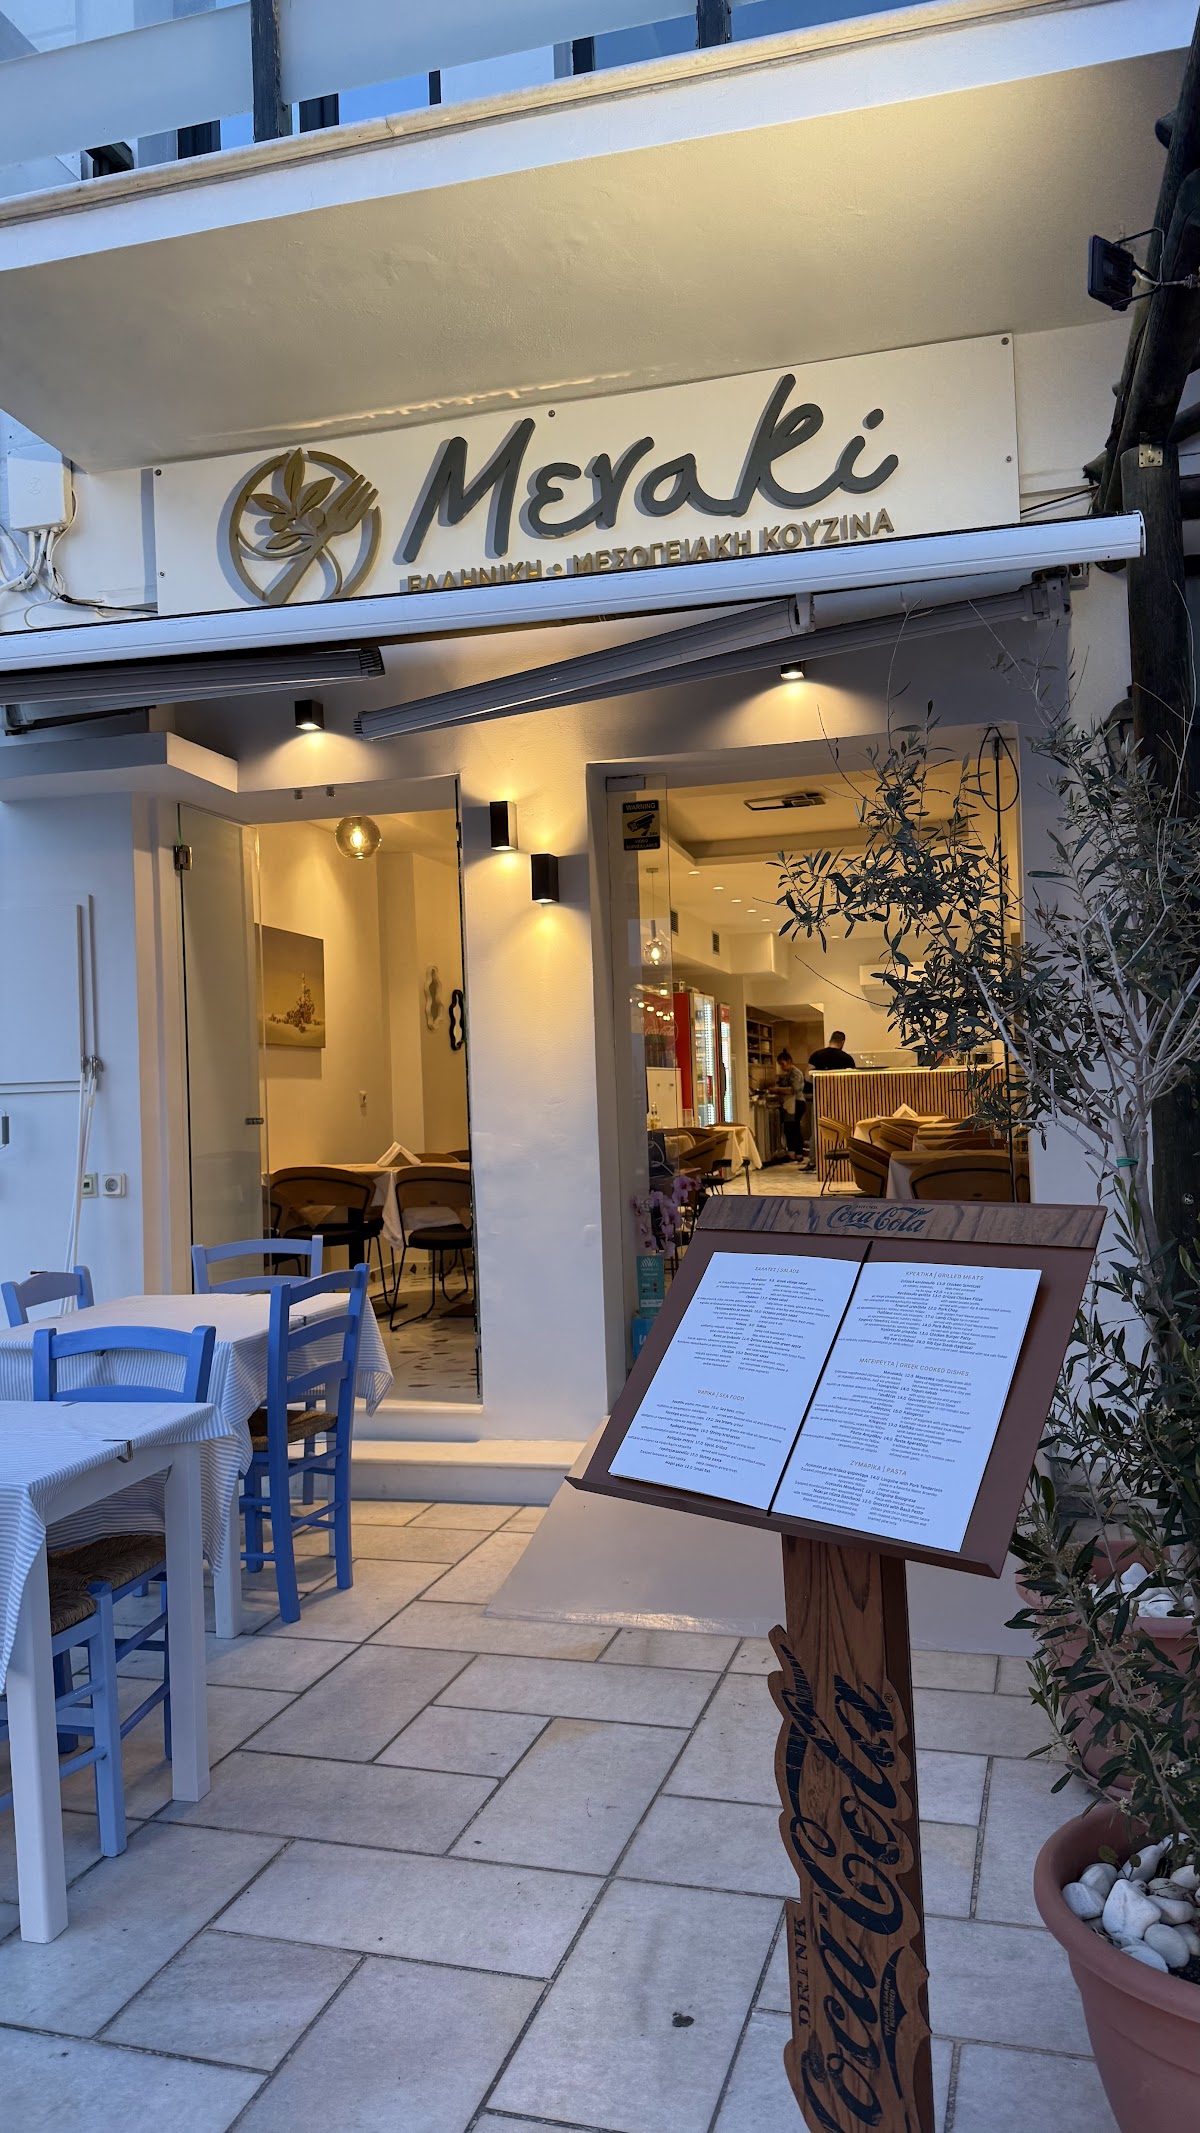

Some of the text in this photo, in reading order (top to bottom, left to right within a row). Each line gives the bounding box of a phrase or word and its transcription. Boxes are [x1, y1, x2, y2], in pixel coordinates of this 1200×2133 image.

[402, 373, 899, 563] Meraki
[406, 508, 895, 593] ΕΛΛΗΝΙΚΗ ΜΕΣΟΓΕΙΑΚΗ ΚΟΥΖΙΝΑ
[625, 802, 656, 811] WARNING
[826, 1204, 934, 1233] Coca-Cola
[918, 1365, 946, 1373] COOKED
[945, 1368, 970, 1376] DISHES
[849, 1459, 907, 1476] ΖΥΜΑΡΙΚΑ PASTA
